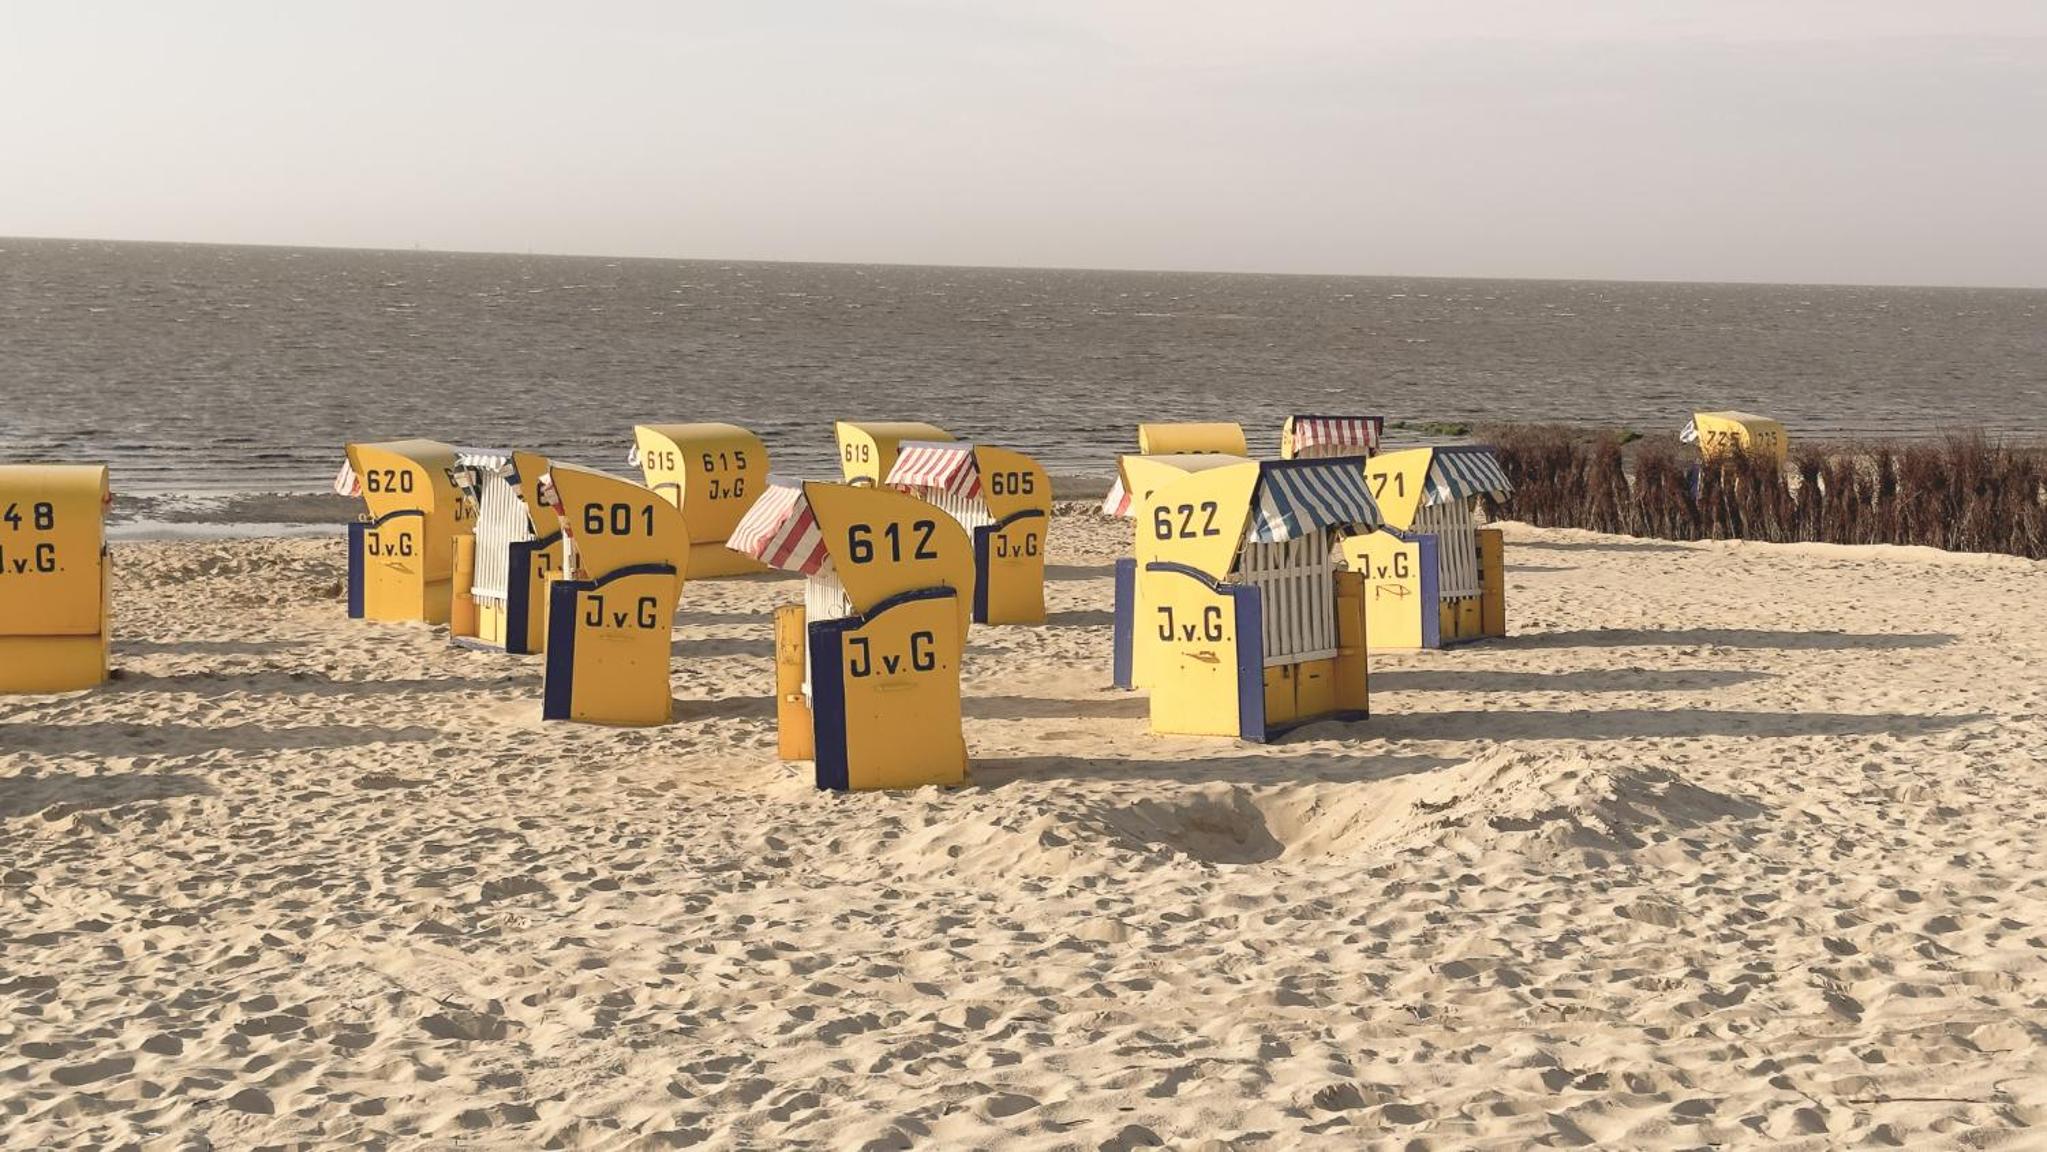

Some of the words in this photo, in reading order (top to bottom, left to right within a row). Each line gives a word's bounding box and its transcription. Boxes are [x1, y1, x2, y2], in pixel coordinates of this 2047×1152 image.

[647, 451, 674, 471] 615
[702, 451, 747, 472] 615
[845, 443, 869, 463] 619
[367, 470, 413, 493] 620
[992, 472, 1034, 495] 605
[584, 503, 654, 537] 601
[1154, 501, 1220, 541] 622
[368, 533, 418, 557] J.v.G.
[848, 520, 938, 564] 612
[996, 533, 1043, 557] J.v.G.
[1357, 552, 1416, 580] J.v.G.
[586, 595, 666, 630] J.v.G.
[1157, 606, 1232, 642] J.v.G.
[848, 631, 947, 678] J.v.G.
